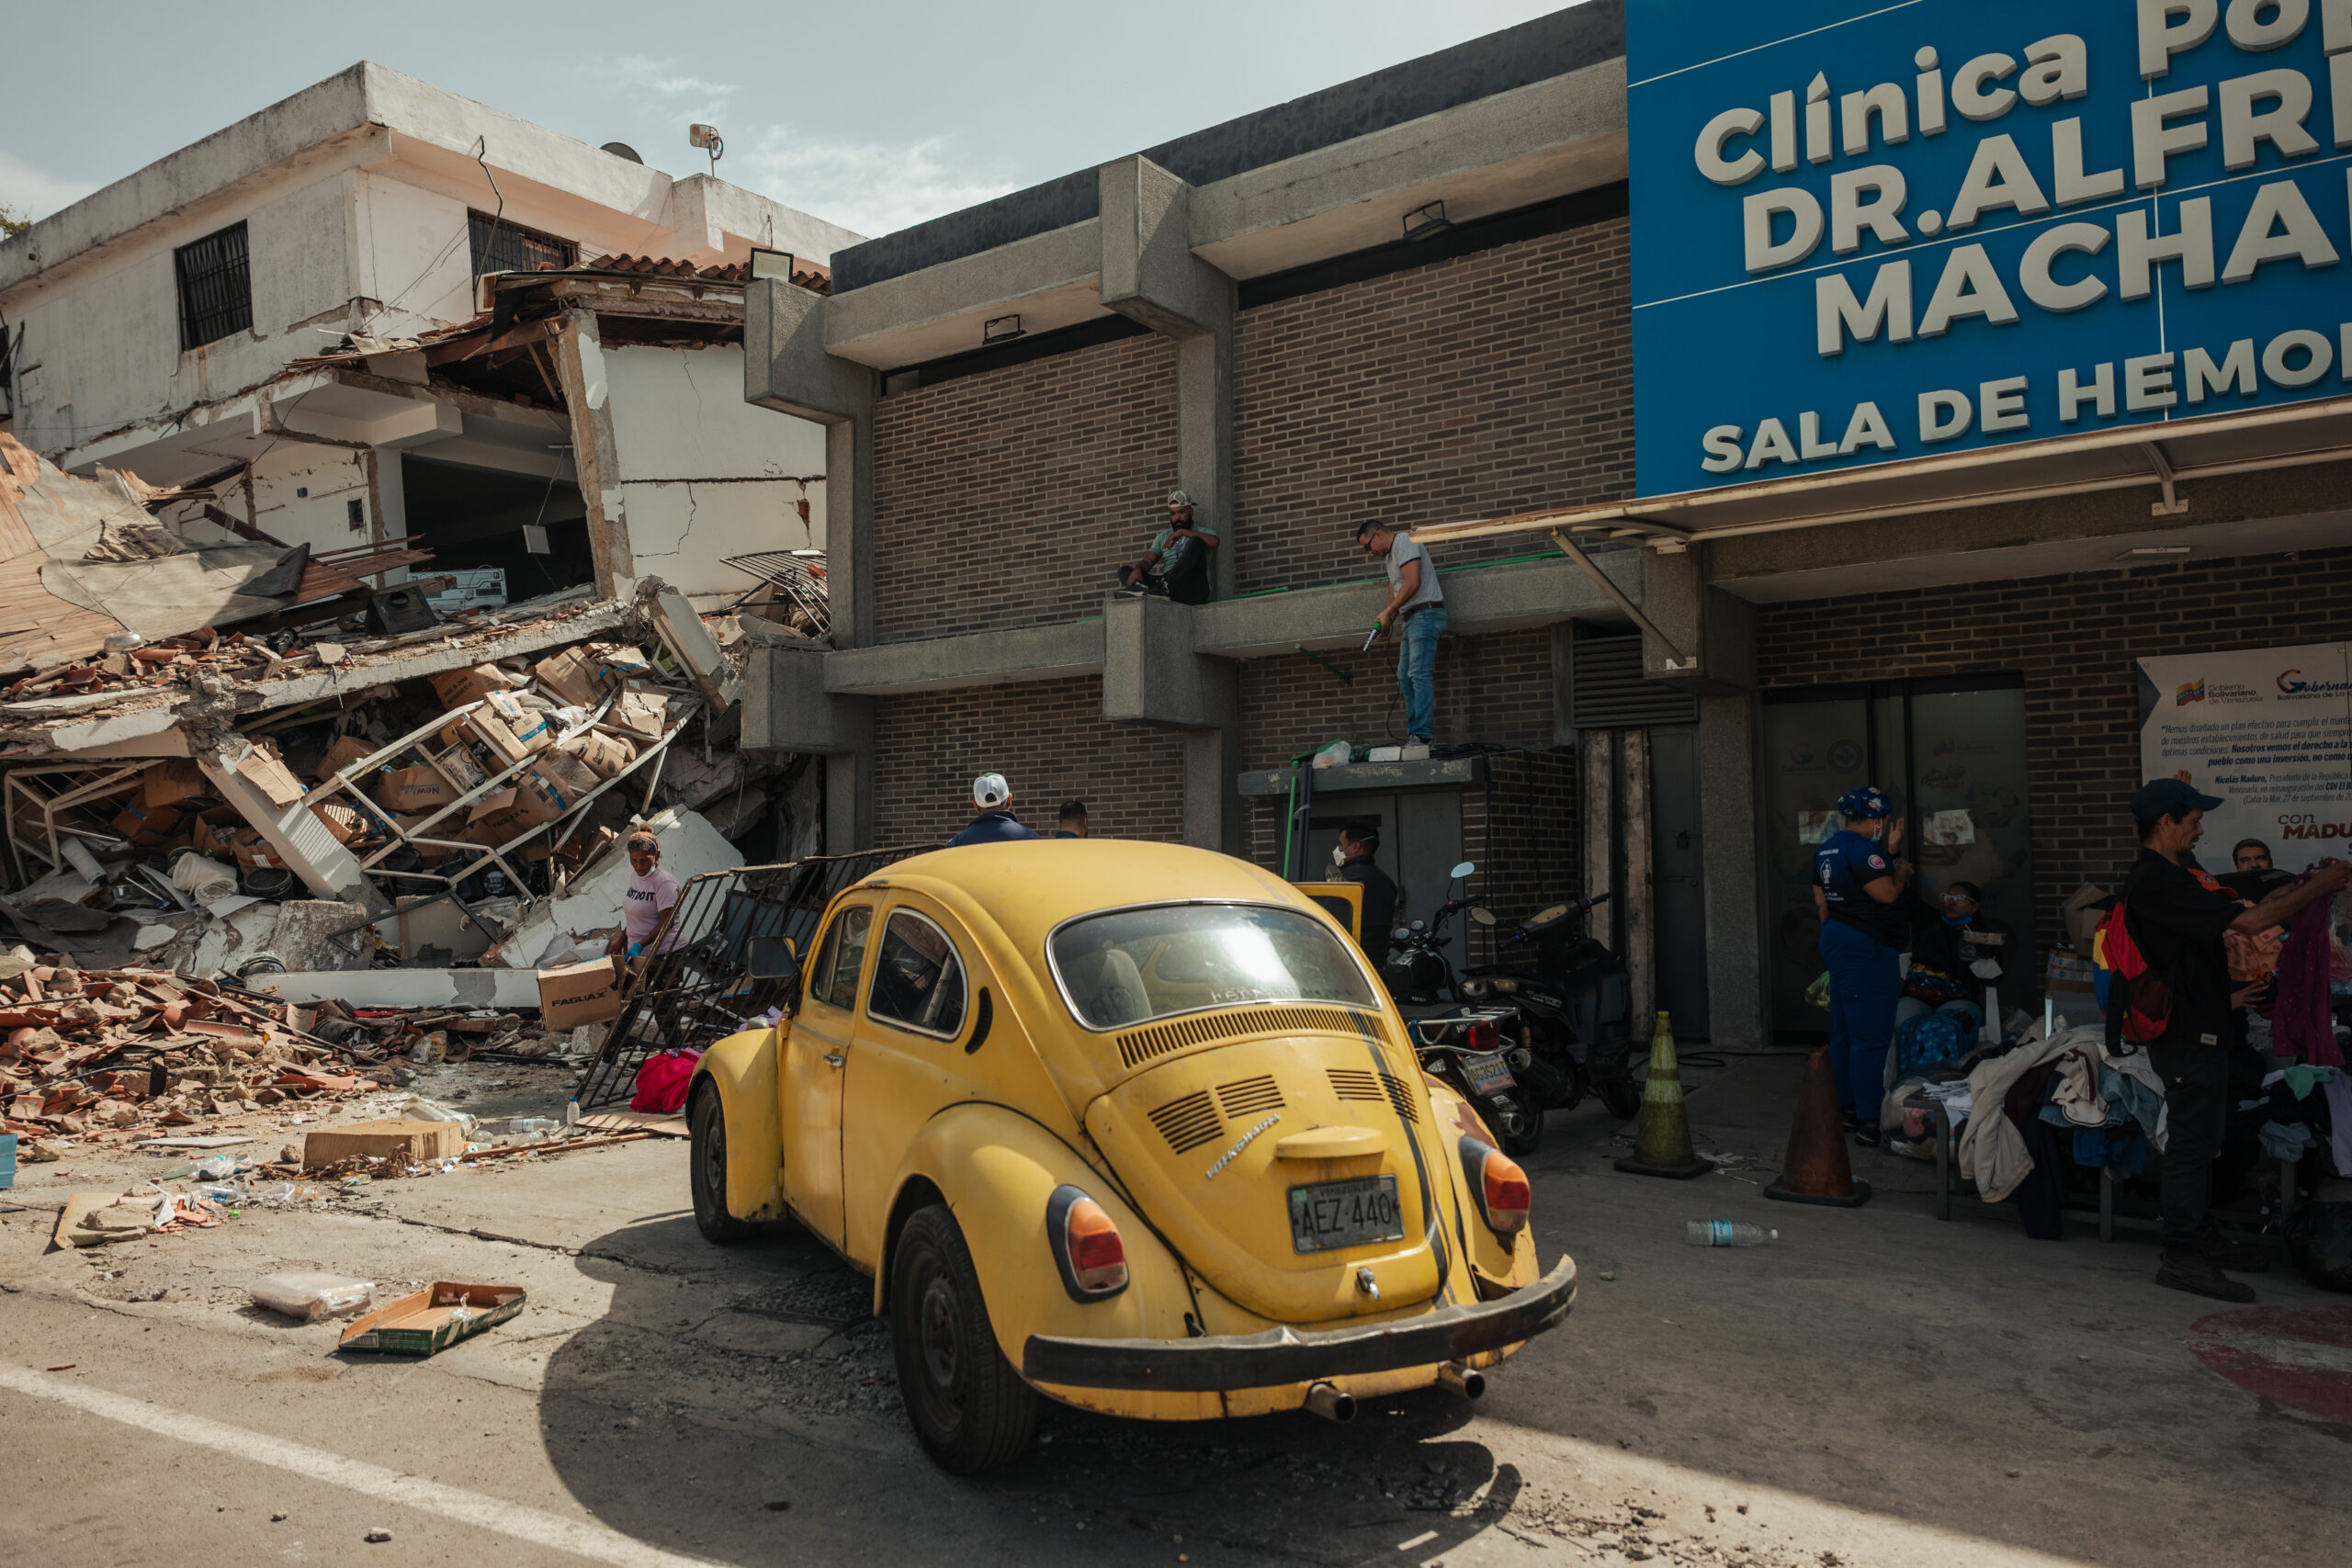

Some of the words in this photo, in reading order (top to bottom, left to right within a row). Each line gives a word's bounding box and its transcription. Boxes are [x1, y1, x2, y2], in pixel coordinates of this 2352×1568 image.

[1694, 32, 2087, 186] Clínica
[1816, 165, 2352, 356] MACHA
[1702, 400, 1898, 474] SALA
[1918, 376, 2030, 444] DE
[2208, 690, 2256, 698] Bolivariano
[2221, 696, 2263, 705] Venezuela
[2189, 722, 2219, 732] diseñado
[2231, 721, 2245, 732] plan
[2247, 719, 2274, 729] efectivo
[2276, 719, 2291, 730] para
[2293, 716, 2319, 728] cumplir
[2322, 716, 2328, 726] el
[2161, 736, 2169, 745] de
[2171, 735, 2199, 744] nuestros
[2200, 732, 2258, 744] establecimientos
[2260, 731, 2268, 740] de
[2270, 730, 2289, 740] salud
[2290, 731, 2306, 741] para
[2307, 730, 2321, 739] que
[2161, 747, 2188, 758] óptimas
[2232, 744, 2266, 753] Nosotros
[2267, 744, 2291, 752] vemos
[2292, 742, 2301, 750] el
[2301, 740, 2333, 750] derecho
[2340, 739, 2347, 748] la
[2208, 757, 2233, 768] pueblo
[2234, 756, 2256, 765] como
[2257, 755, 2271, 763] una
[2312, 753, 2323, 761] no
[2324, 752, 2346, 761] como
[2215, 775, 2239, 784] Nicolás
[2240, 773, 2267, 784] Maduro,
[2269, 773, 2301, 783] Presidente
[2302, 772, 2311, 781] de
[2312, 772, 2317, 780] la
[2318, 771, 2347, 782] República
[2268, 784, 2314, 795] reinauguración
[2315, 783, 2324, 792] del
[2325, 782, 2338, 791] CDI
[2262, 795, 2268, 803] la
[2282, 795, 2291, 803] 27
[2291, 794, 2300, 802] de
[2301, 793, 2335, 805] septiembre
[2336, 793, 2345, 801] de
[2278, 813, 2315, 825] con
